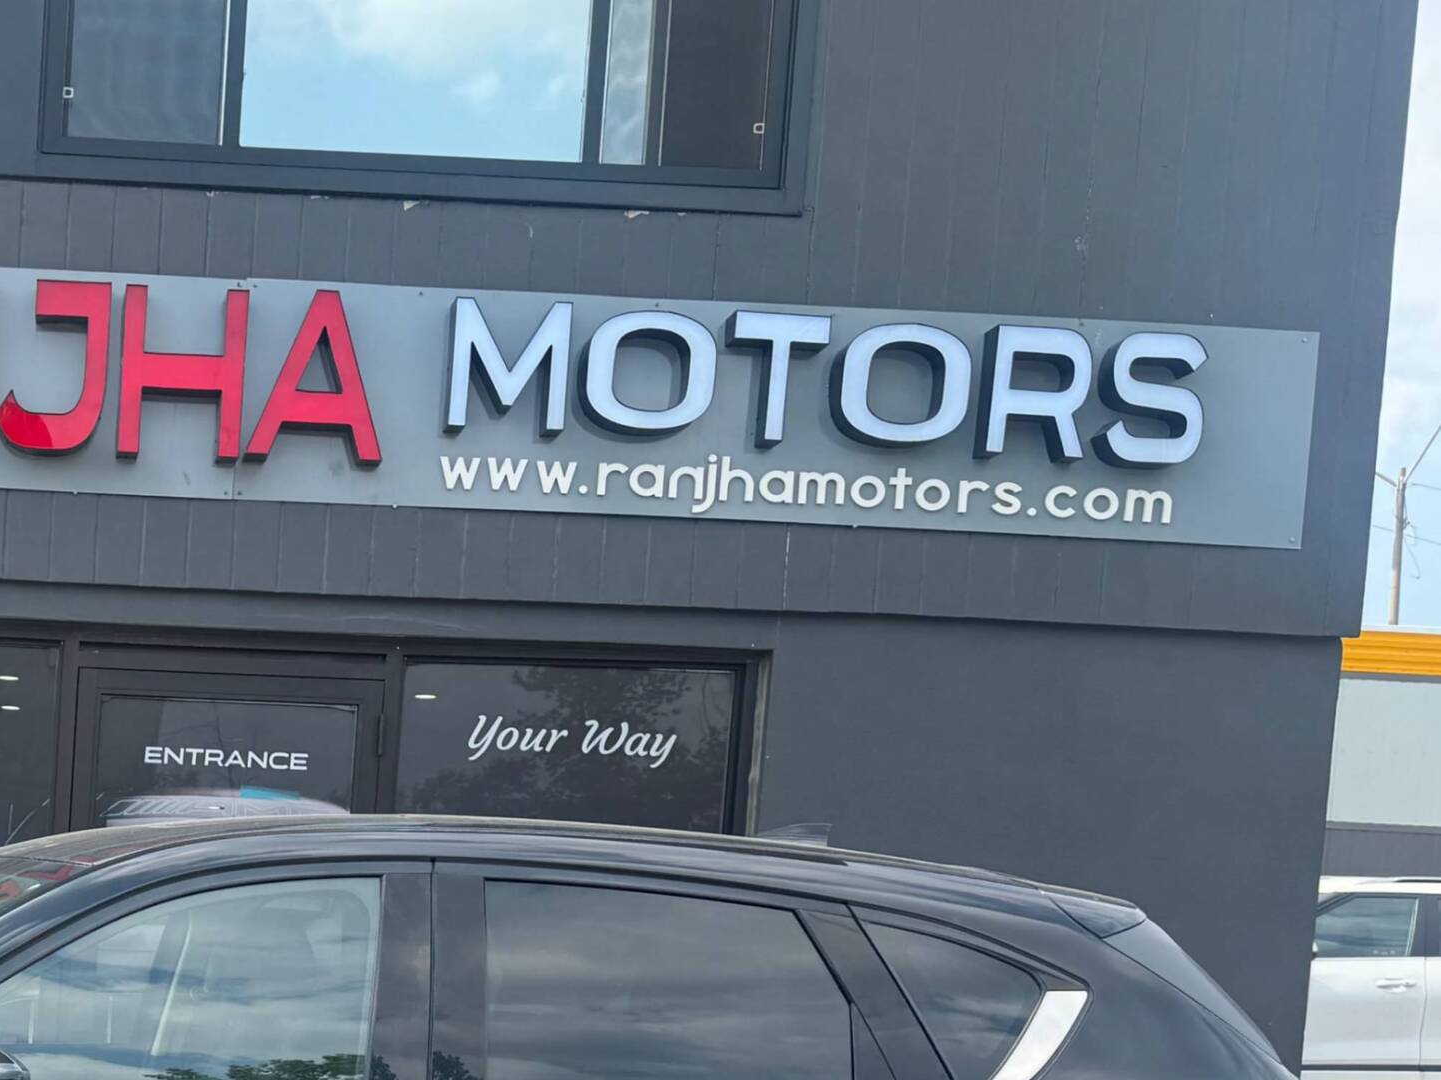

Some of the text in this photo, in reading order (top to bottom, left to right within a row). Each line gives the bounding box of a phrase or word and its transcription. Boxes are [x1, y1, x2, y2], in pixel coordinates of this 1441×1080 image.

[442, 296, 1209, 469] MOTORS
[439, 453, 1173, 524] www.ranjhamotors.com
[144, 746, 309, 771] ENTRANCE
[467, 714, 677, 769] Your Way
